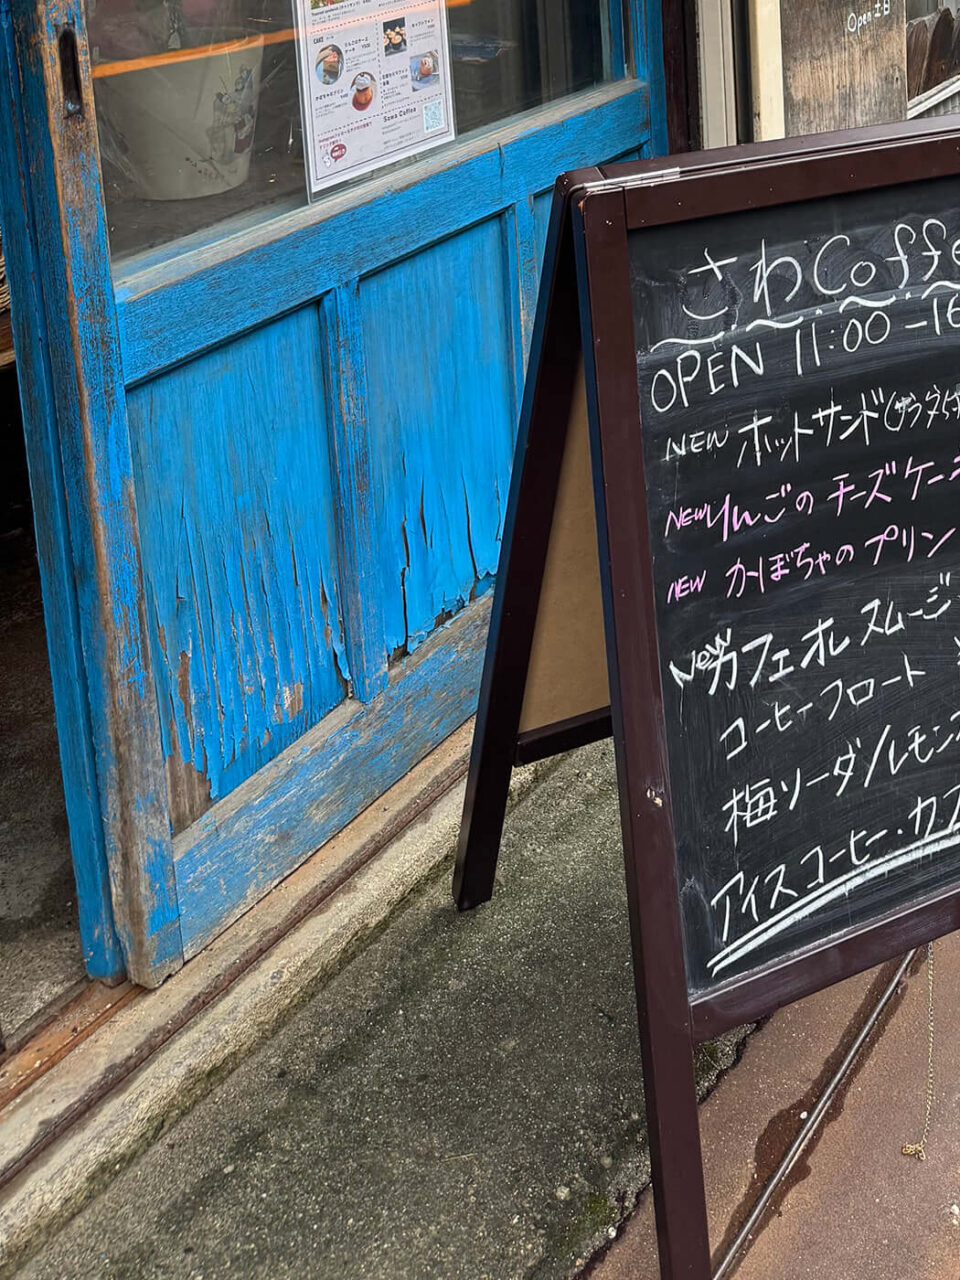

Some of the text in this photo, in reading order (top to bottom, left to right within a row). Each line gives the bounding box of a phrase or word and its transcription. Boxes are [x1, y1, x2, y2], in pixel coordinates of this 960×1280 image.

[651, 342, 764, 413] OPEN
[663, 429, 729, 462] NEW
[664, 503, 708, 538] NEW
[667, 570, 707, 604] NEW
